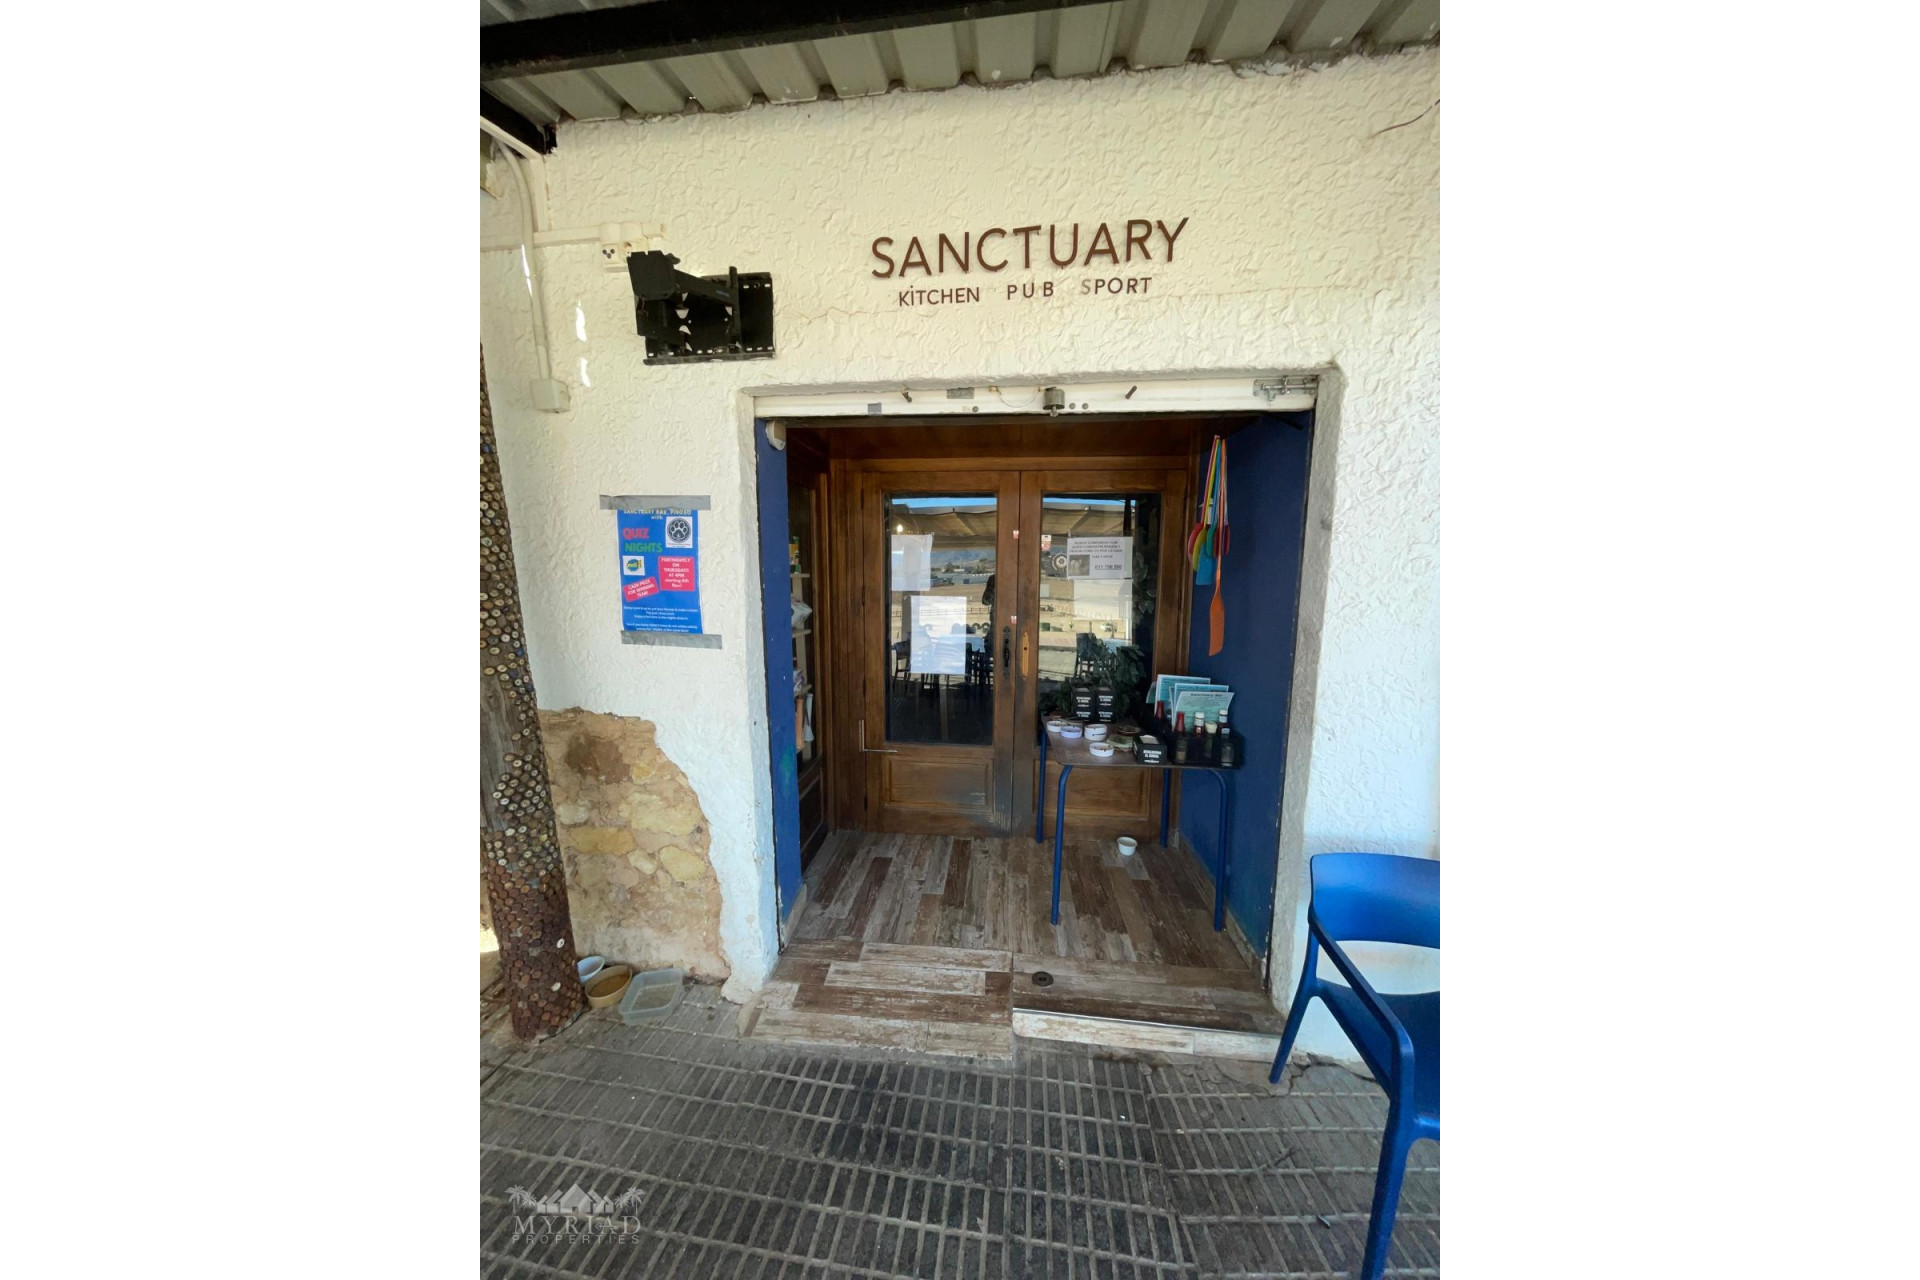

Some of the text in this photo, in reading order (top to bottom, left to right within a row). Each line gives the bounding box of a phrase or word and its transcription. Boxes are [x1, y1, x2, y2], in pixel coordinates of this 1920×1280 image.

[871, 217, 1189, 279] SANCTUARY
[1007, 281, 1054, 300] PUB
[1081, 277, 1152, 295] SPORT
[622, 528, 649, 540] QUIZ
[624, 542, 663, 553] NIGHTS
